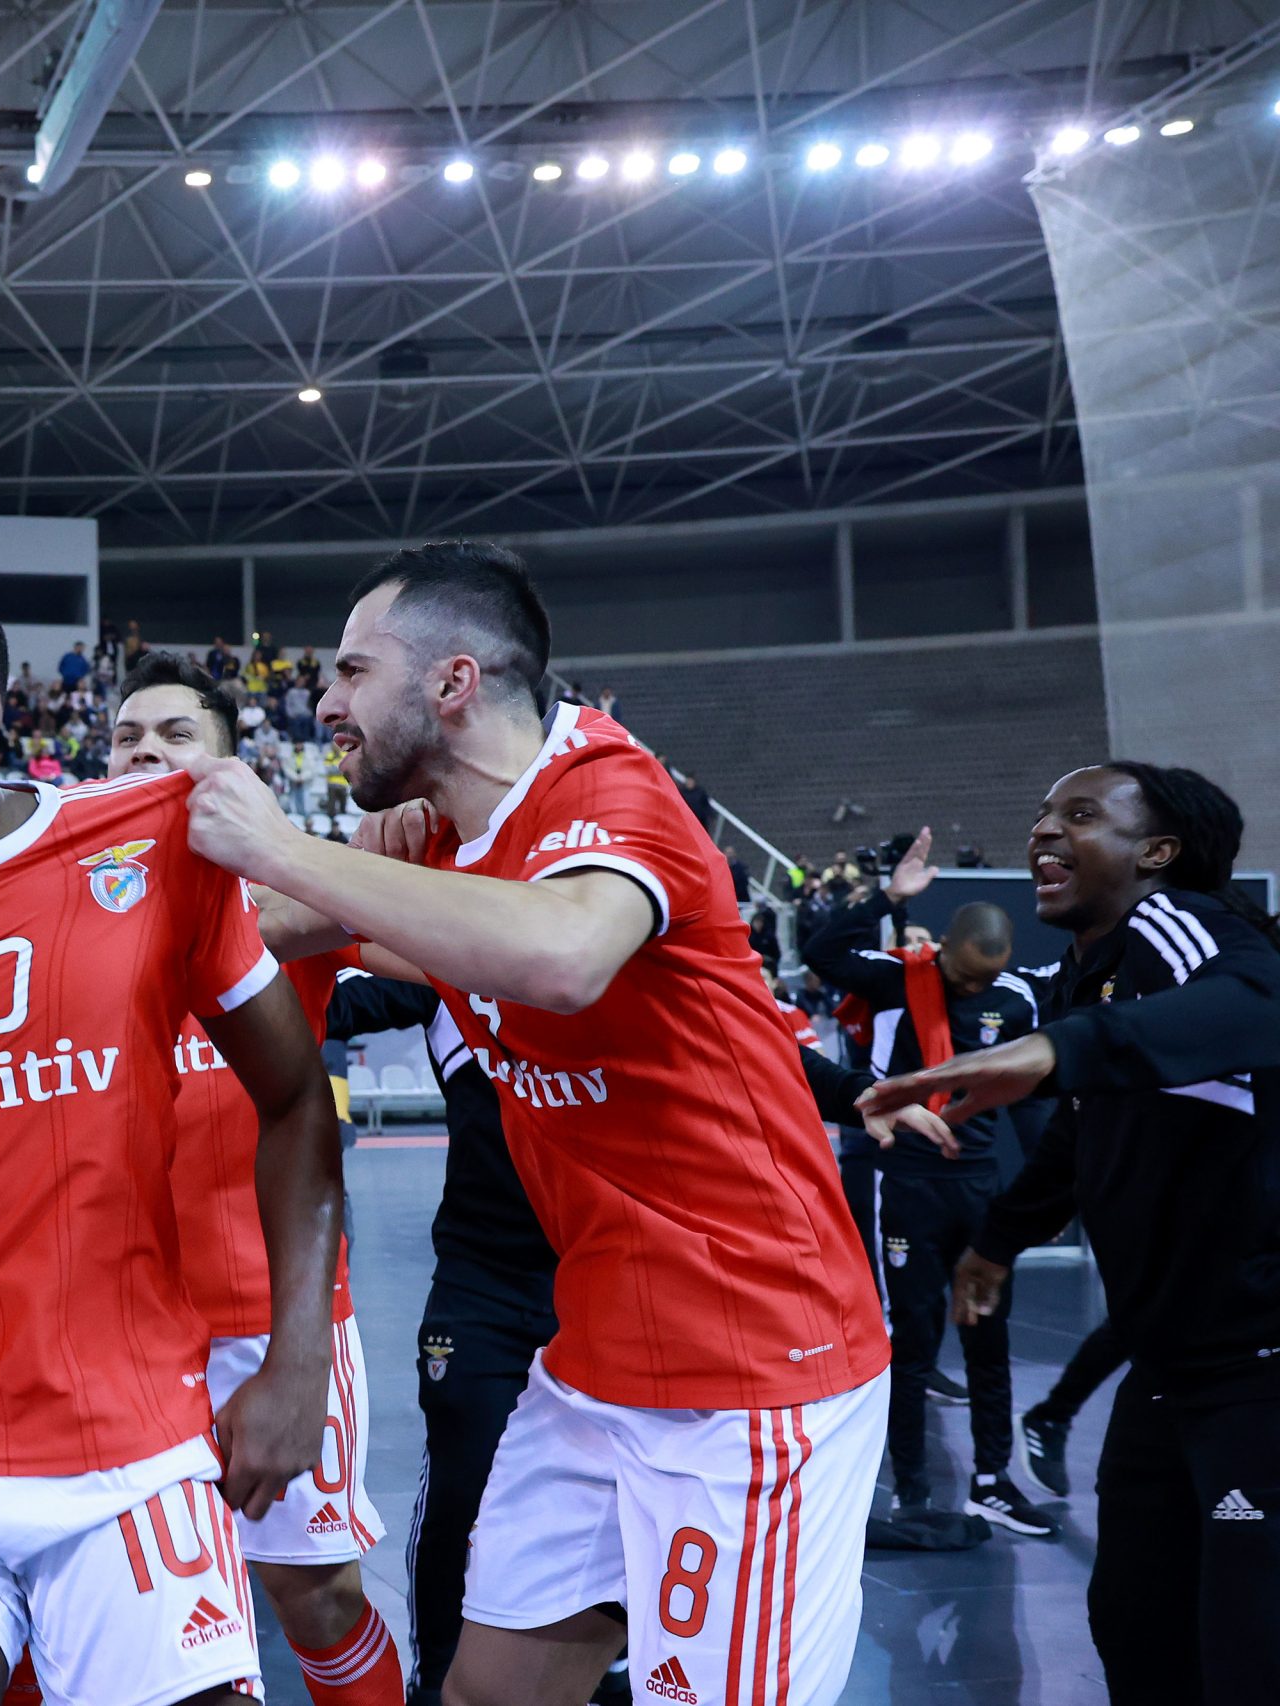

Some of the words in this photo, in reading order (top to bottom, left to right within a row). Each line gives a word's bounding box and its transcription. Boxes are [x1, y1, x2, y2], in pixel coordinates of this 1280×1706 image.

[305, 1521, 349, 1534] adidas
[1211, 1508, 1266, 1521] adidas
[658, 1525, 719, 1639] 8
[180, 1619, 243, 1650] adidas
[645, 1678, 699, 1706] adidas
